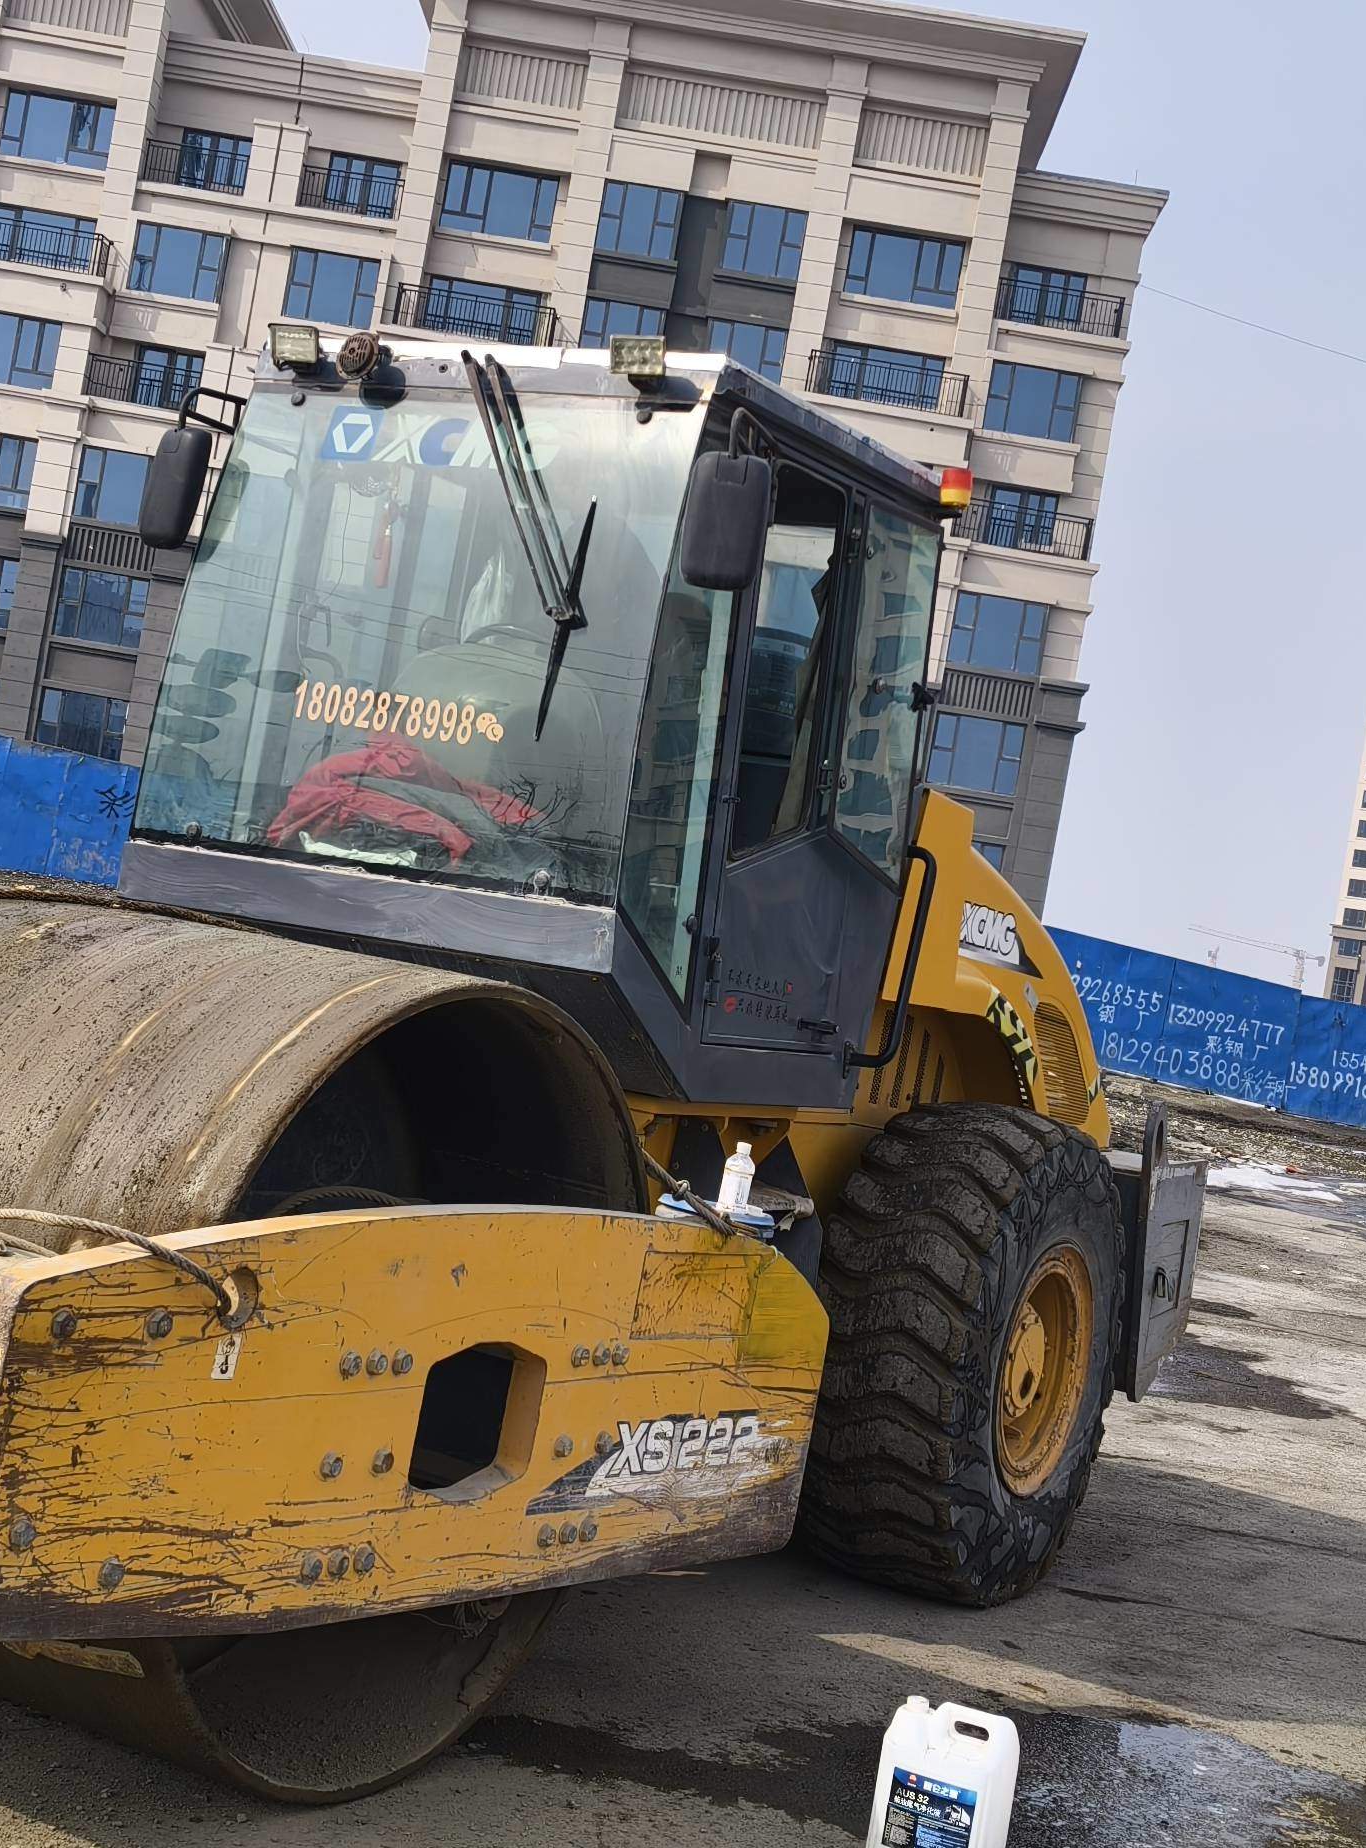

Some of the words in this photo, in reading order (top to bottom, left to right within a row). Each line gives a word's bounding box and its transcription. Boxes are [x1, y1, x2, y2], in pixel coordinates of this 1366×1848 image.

[372, 413, 560, 470] XCMG
[294, 679, 476, 745] 18082878998
[960, 900, 1017, 956] XCMG
[1169, 1003, 1285, 1045] 13209924777
[605, 1415, 759, 1478] XS222
[895, 1787, 916, 1800] AUS
[917, 1793, 929, 1805] 32
